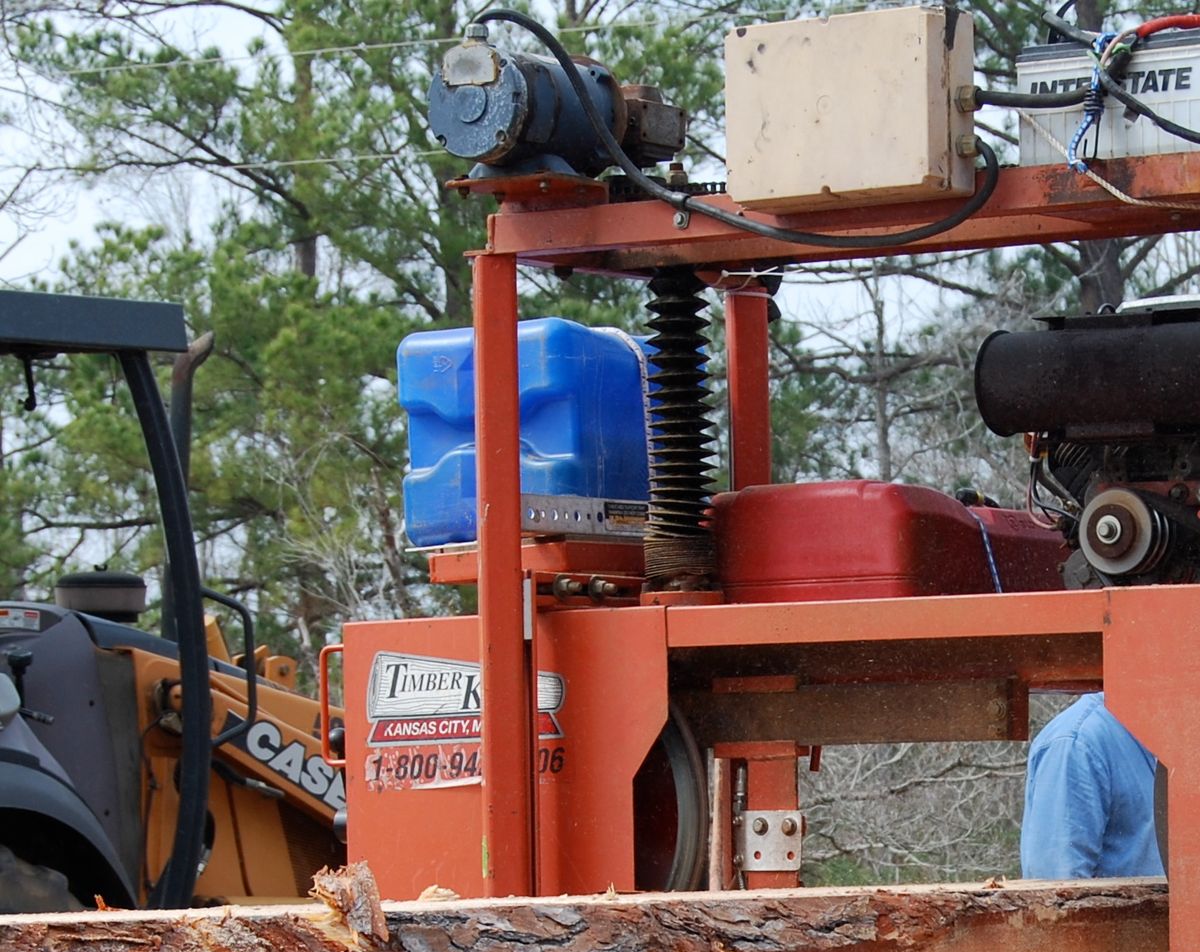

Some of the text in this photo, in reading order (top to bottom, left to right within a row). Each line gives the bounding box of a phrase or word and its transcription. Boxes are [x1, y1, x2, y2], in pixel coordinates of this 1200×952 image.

[1030, 67, 1192, 95] INTETATE
[386, 663, 463, 698] TIMBER
[384, 721, 437, 737] KANSAS
[438, 719, 471, 736] CITY,
